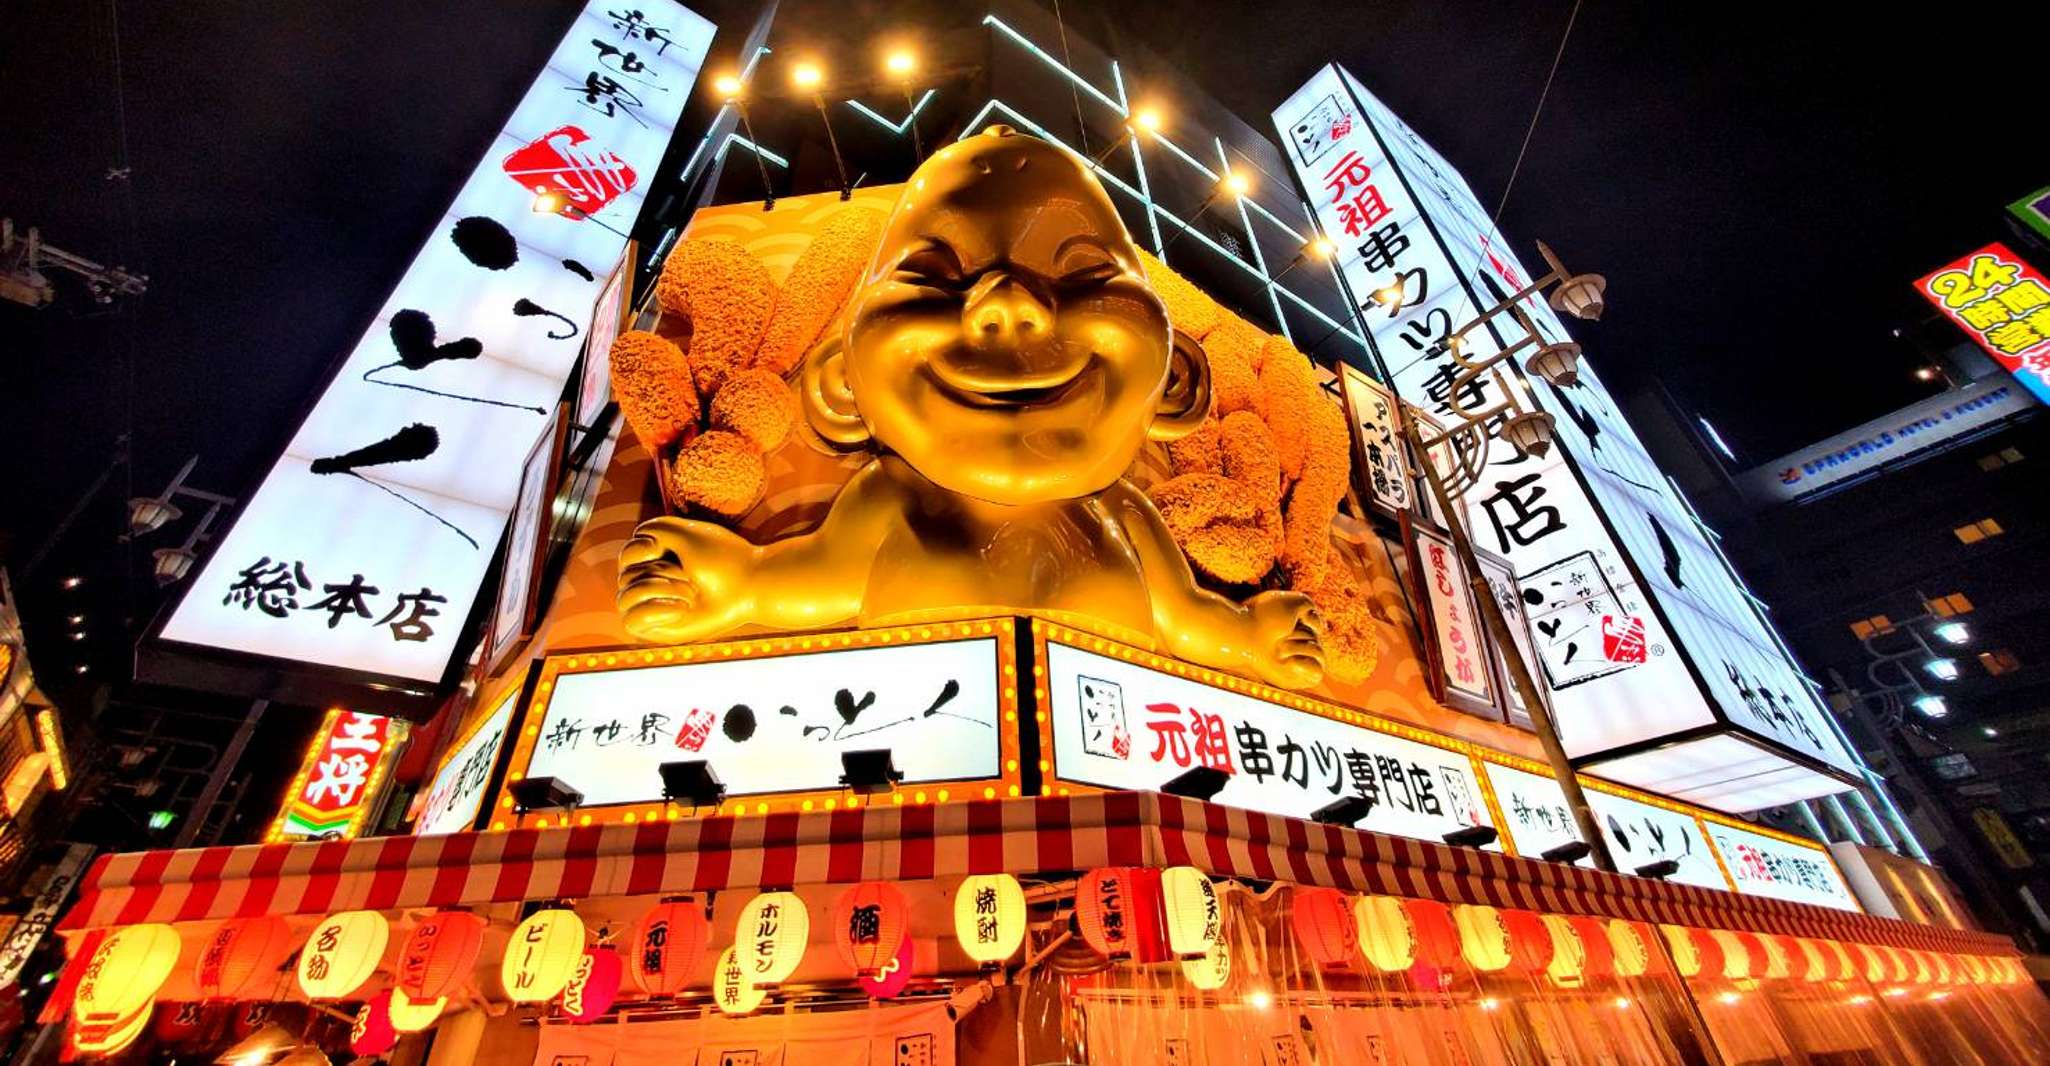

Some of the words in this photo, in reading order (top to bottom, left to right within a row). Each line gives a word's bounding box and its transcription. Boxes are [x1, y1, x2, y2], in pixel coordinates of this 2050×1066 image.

[565, 8, 690, 130] 新世界
[1930, 256, 2018, 308] 24
[222, 556, 448, 641] 総本店
[305, 711, 390, 805] 王将
[546, 711, 674, 757] 新世界
[755, 903, 780, 973] ホルモン
[849, 904, 880, 945] 酒
[975, 886, 998, 943] 焼酎
[306, 925, 342, 981] 名物
[514, 922, 549, 990] ビール
